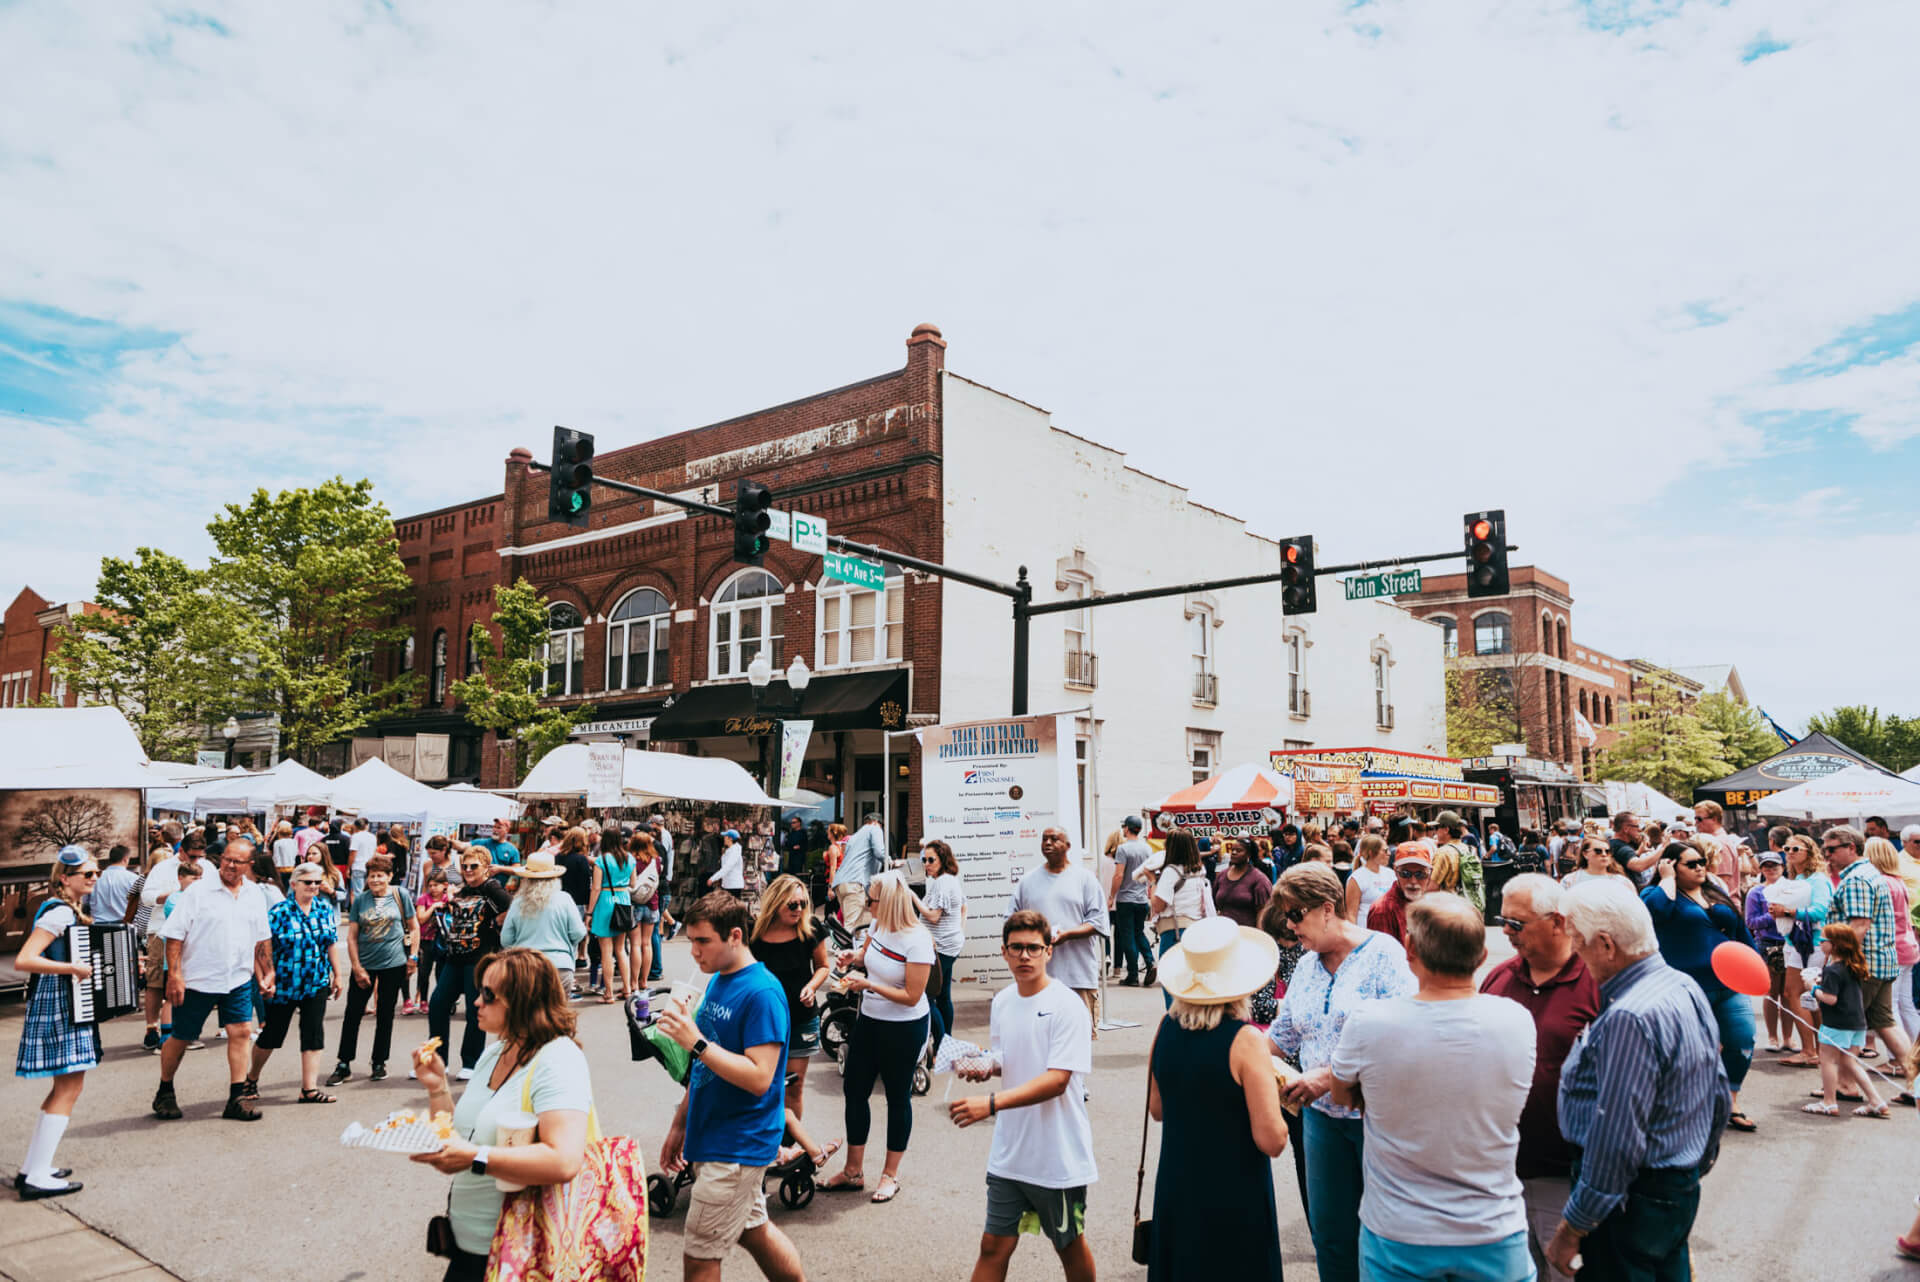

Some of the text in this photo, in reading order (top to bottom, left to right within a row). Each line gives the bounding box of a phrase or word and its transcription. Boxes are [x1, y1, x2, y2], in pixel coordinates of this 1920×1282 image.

[796, 520, 810, 543] P
[835, 560, 841, 574] N
[854, 565, 867, 581] Ave
[869, 570, 875, 583] S
[1346, 571, 1420, 599] Main Street
[580, 720, 648, 732] MERCANTILE
[952, 724, 1024, 743] THANK YOU TO OUR
[939, 739, 1039, 759] SPONSORS AND PARTNERS
[1779, 765, 1841, 773] RESTAURANT
[1361, 782, 1404, 790] RIBBON
[1367, 789, 1399, 797] FRIES
[1725, 791, 1746, 806] BE
[1176, 810, 1261, 825] DEEP FRIED
